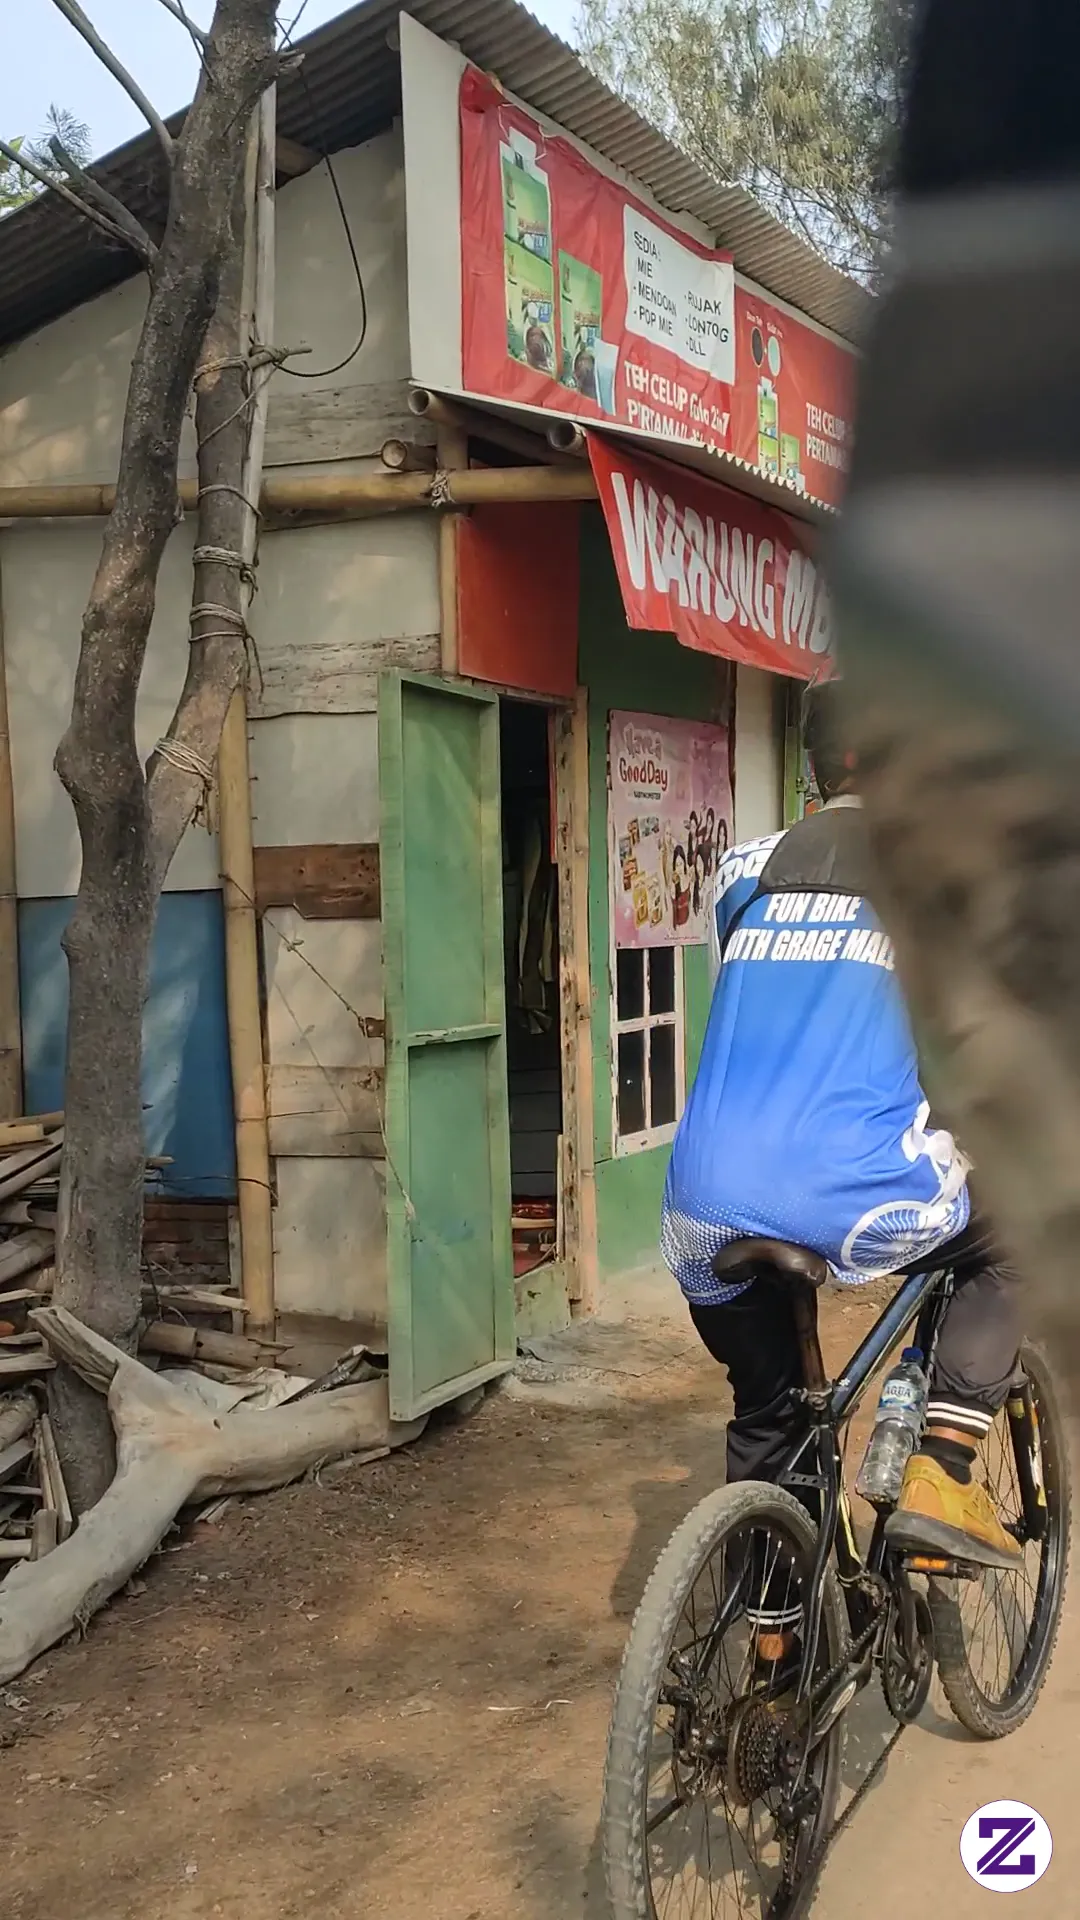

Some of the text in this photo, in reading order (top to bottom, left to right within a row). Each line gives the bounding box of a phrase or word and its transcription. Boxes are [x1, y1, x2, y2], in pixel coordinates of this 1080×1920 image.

[637, 256, 653, 279] MIE
[638, 280, 677, 317] MENDOAN
[687, 290, 722, 316] RUJAK
[639, 305, 674, 337] POP MIE
[688, 313, 730, 343] LONTOG
[689, 336, 707, 356] DLL
[624, 360, 649, 394] TEH
[650, 373, 688, 412] CELUP
[806, 401, 822, 432] TEH
[611, 472, 776, 640] WARUNG
[763, 892, 862, 923] FUN BIKE
[771, 929, 847, 962] GRAGE
